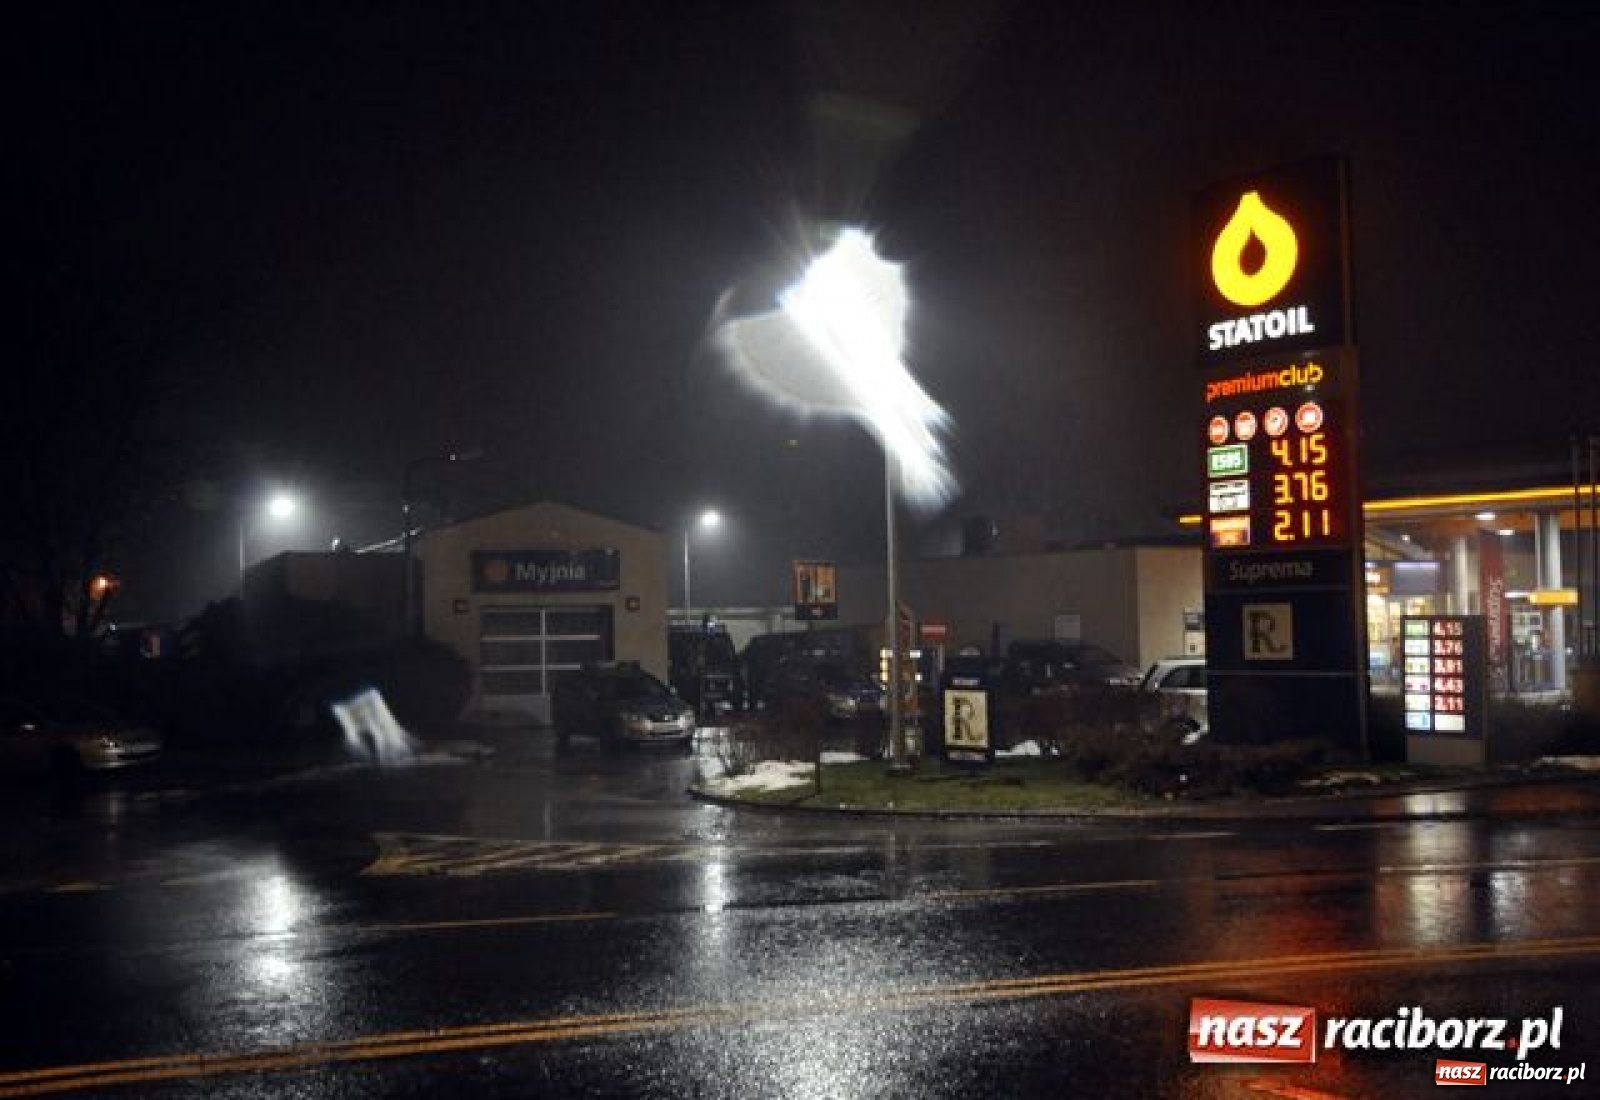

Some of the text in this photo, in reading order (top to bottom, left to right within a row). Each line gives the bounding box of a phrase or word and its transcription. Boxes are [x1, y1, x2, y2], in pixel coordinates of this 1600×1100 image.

[1208, 305, 1315, 350] STATOIL
[1206, 362, 1324, 402] premiumclub
[516, 560, 586, 586] Myjnia
[1229, 559, 1314, 584] Suprema
[1247, 610, 1289, 653] R
[952, 696, 984, 741] R
